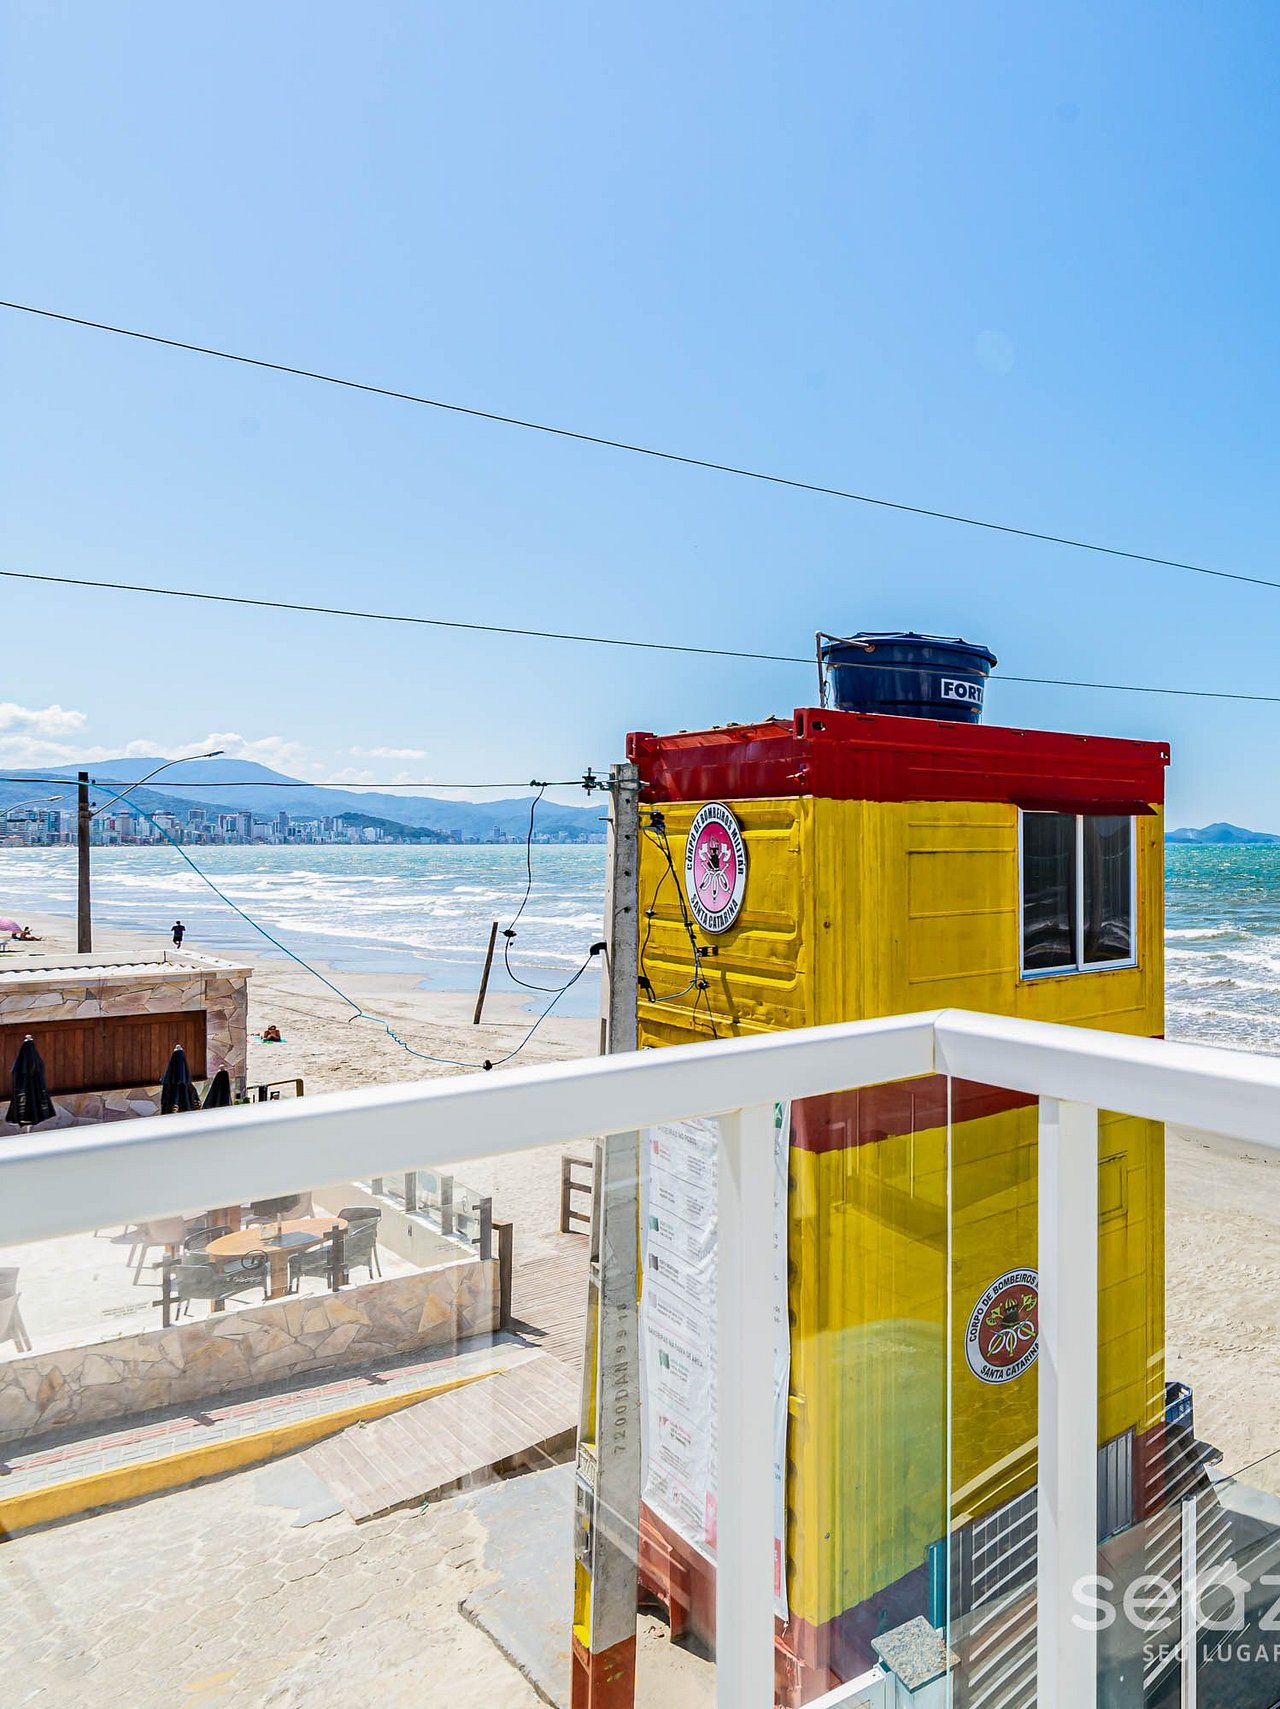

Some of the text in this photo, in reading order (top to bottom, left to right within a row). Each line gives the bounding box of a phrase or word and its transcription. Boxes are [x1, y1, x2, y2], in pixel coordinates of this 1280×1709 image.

[686, 806, 745, 875] CORPO DE BOMBEIROS MILITAR
[690, 893, 739, 930] SANTA CATARINA
[969, 1273, 1037, 1343] CORPO DE BOMBEIROS
[980, 1365, 1004, 1379] SANTA
